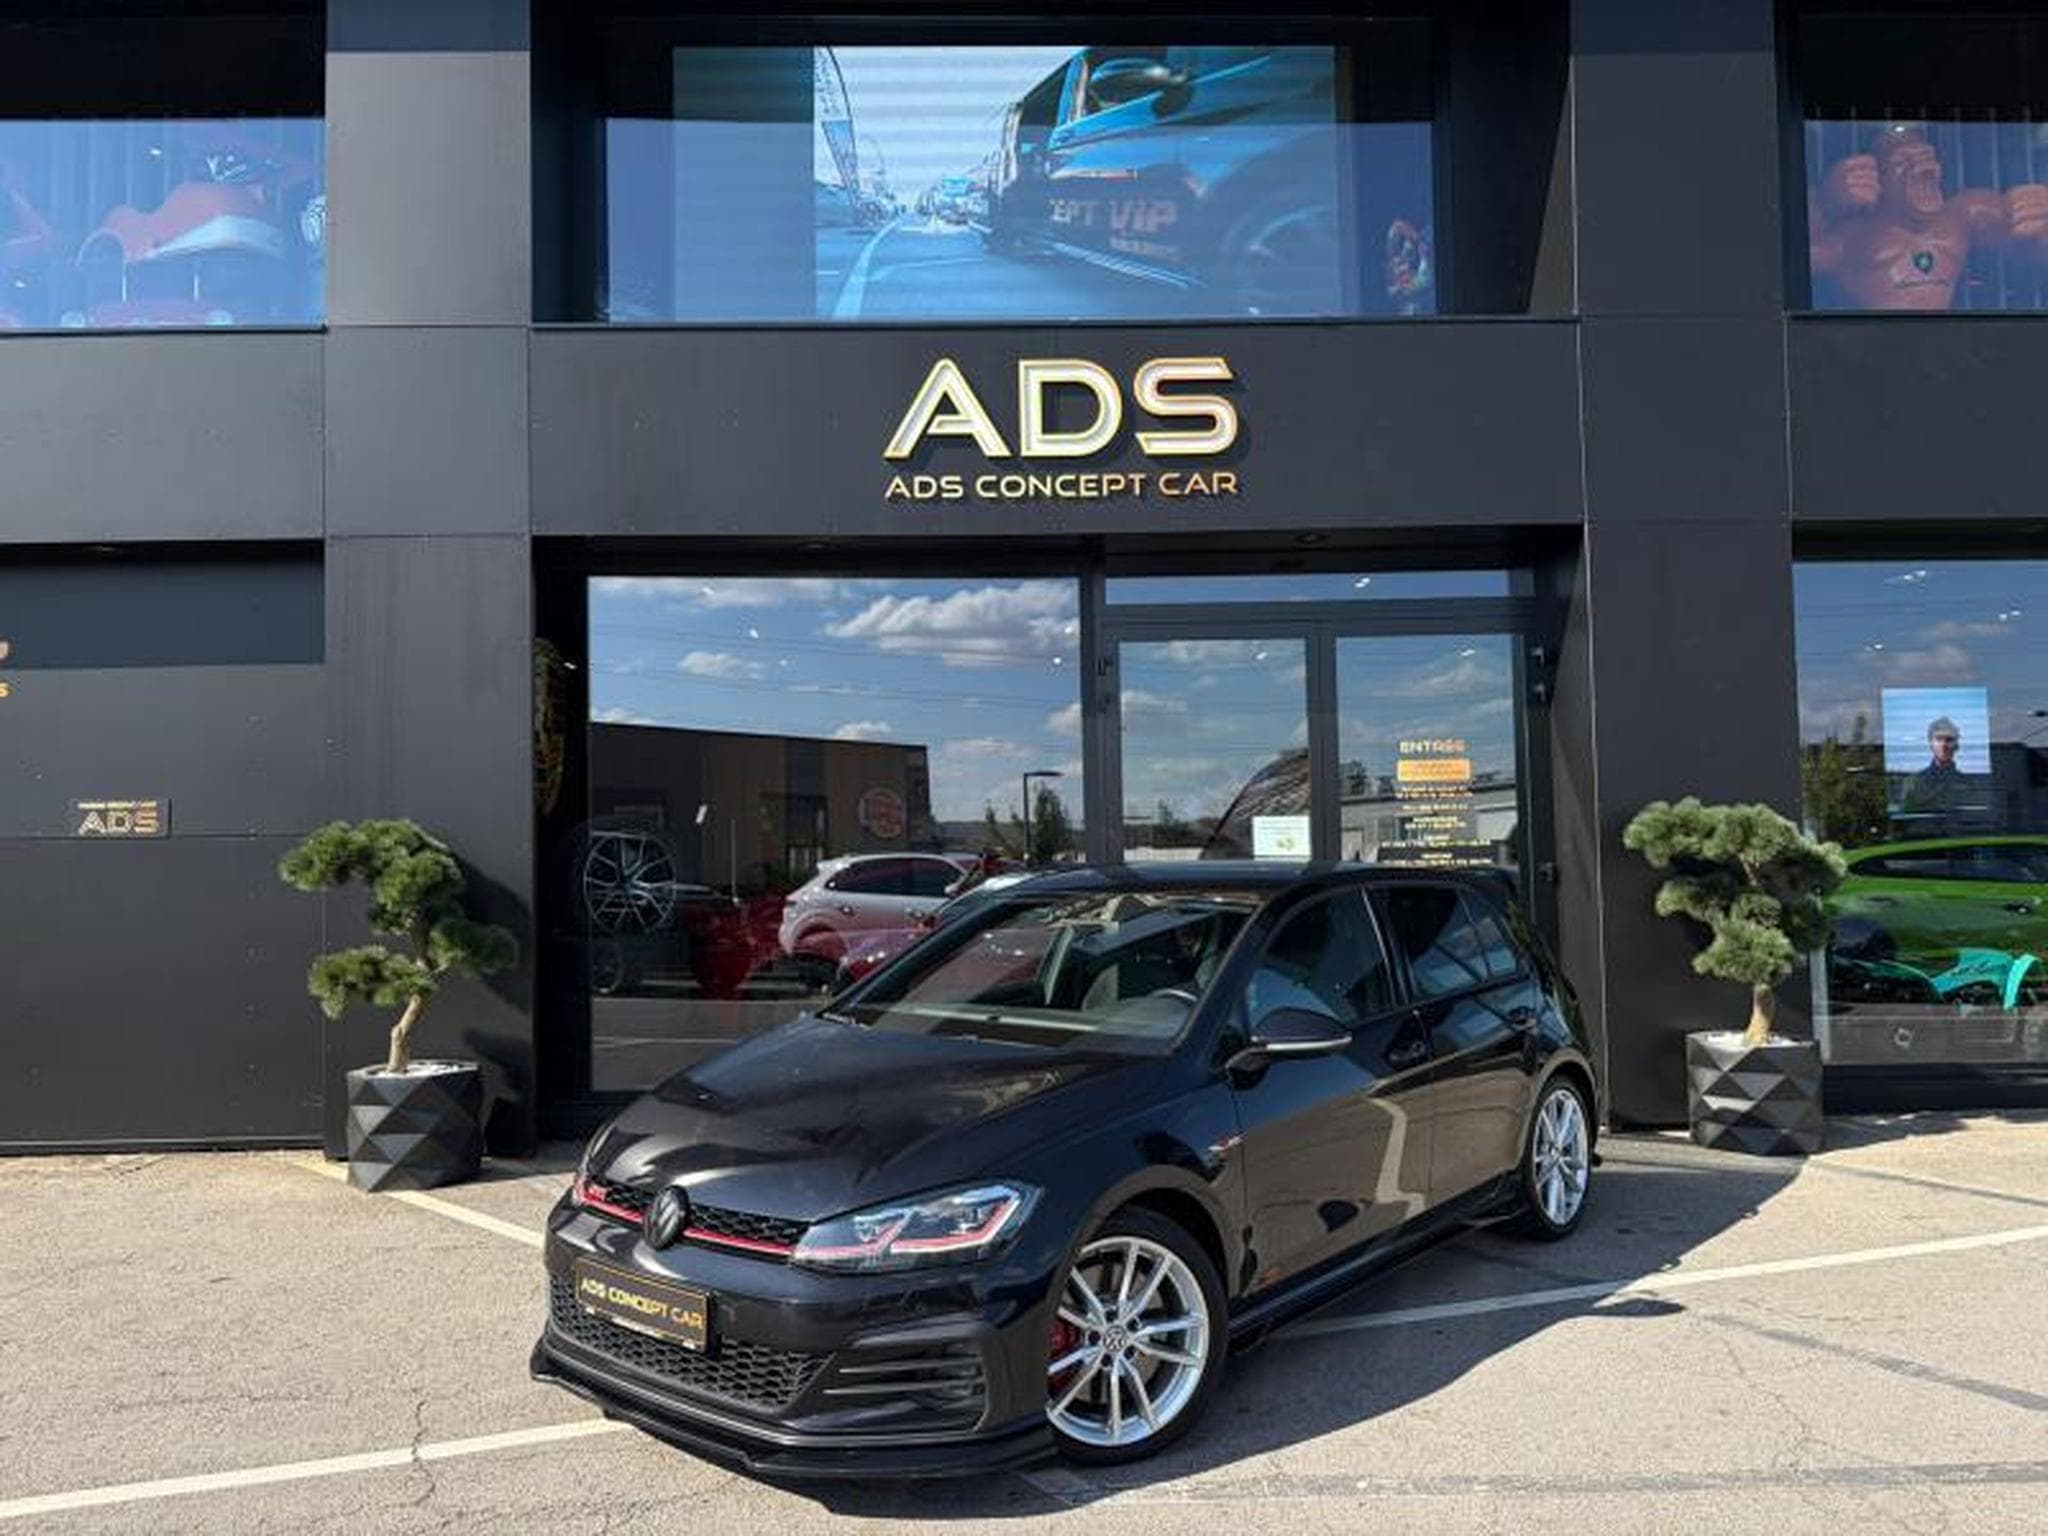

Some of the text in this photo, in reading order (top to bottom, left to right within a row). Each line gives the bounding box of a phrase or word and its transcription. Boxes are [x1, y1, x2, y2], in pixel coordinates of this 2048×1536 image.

[884, 357, 1239, 459] ADS
[885, 472, 1238, 499] ADS CONCEPT CAR
[78, 811, 160, 834] ADS
[580, 1278, 703, 1329] ADS CONCEPT CAR
